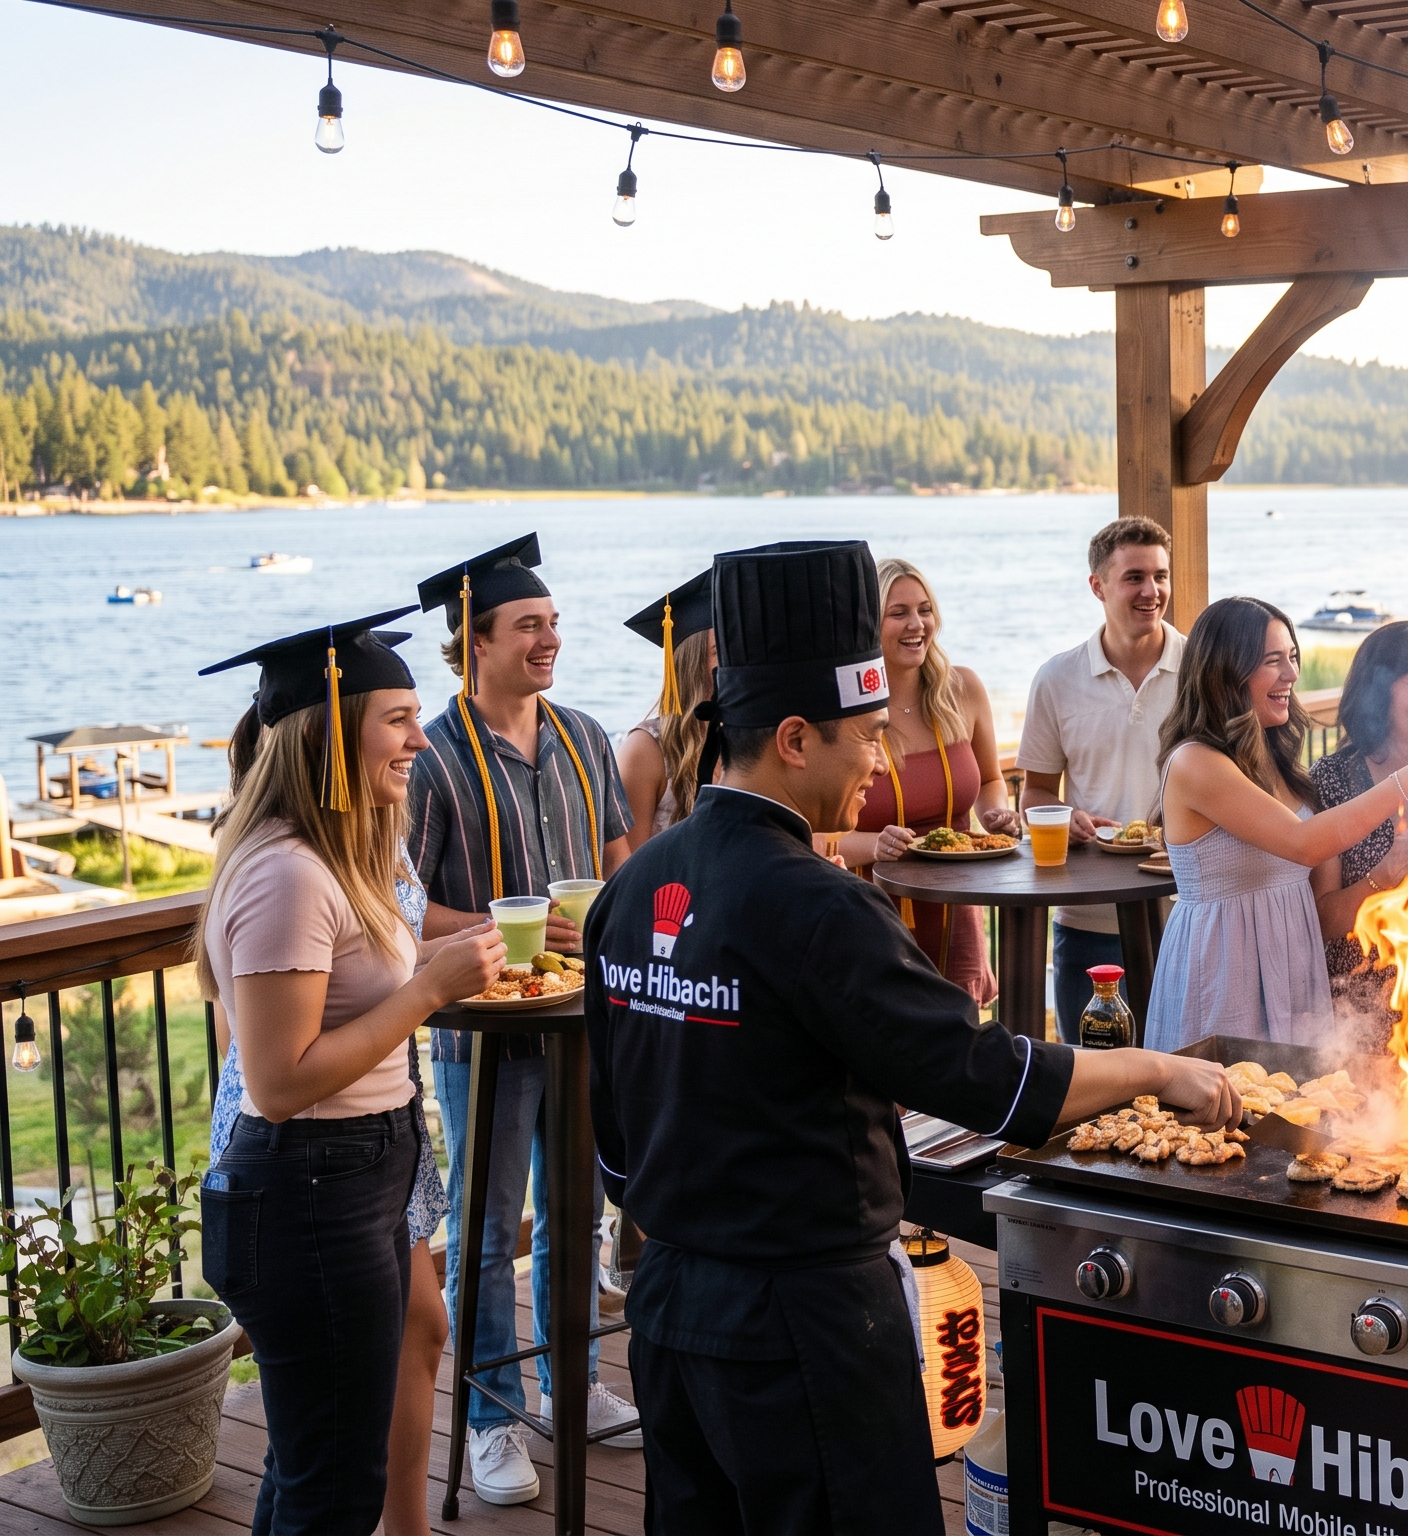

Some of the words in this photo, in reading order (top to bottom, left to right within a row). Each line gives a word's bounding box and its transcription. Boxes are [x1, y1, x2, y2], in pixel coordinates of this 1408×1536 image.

[647, 962, 739, 1011] Hibachi
[1094, 1378, 1235, 1470] Love
[1134, 1470, 1271, 1525] Professional
[1279, 1503, 1357, 1536] Mobile
